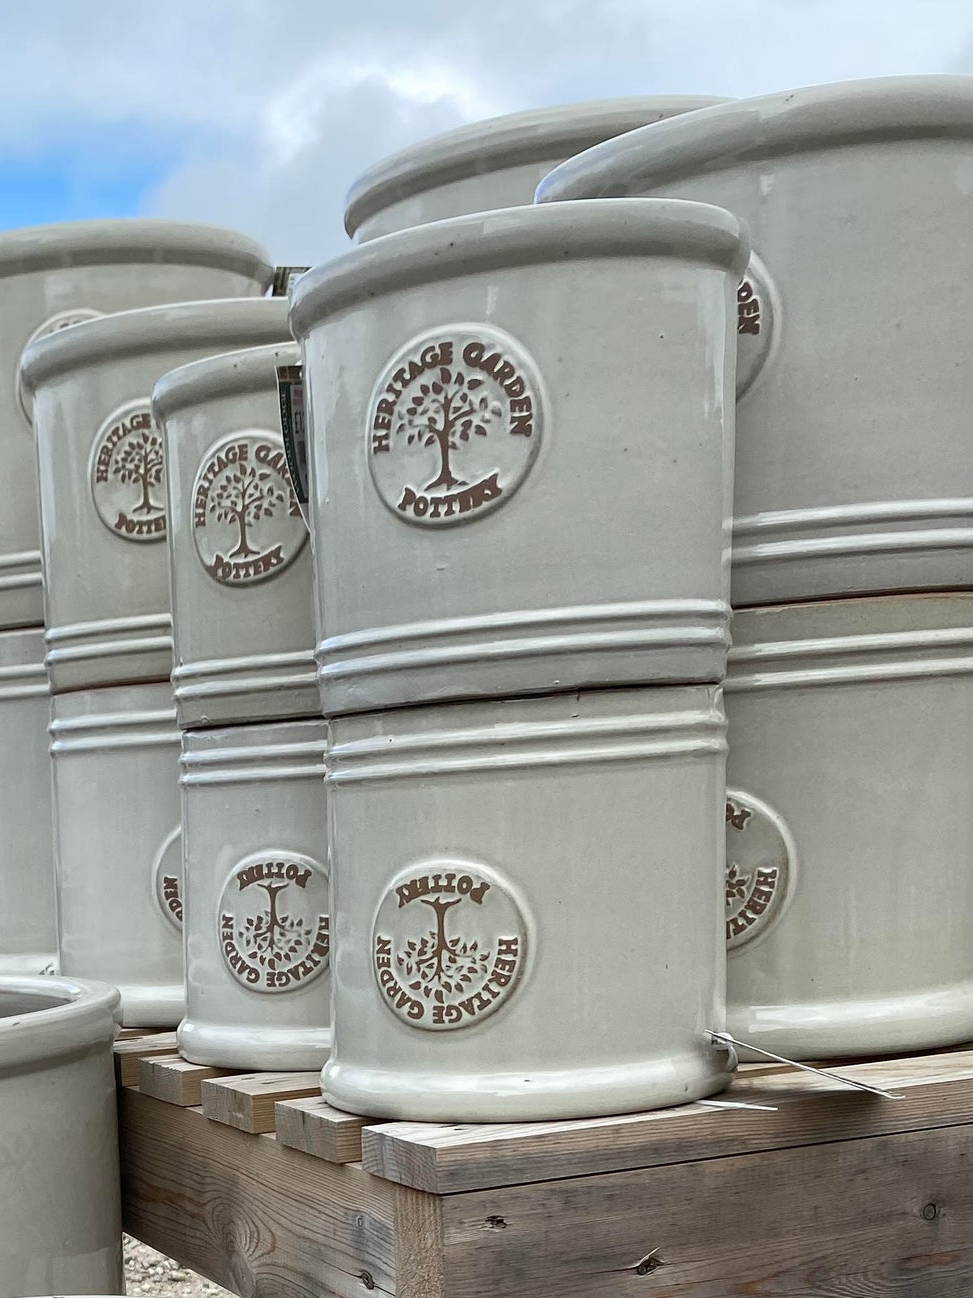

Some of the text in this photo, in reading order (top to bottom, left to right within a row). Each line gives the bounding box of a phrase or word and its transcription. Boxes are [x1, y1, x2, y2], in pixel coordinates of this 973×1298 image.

[737, 281, 760, 335] DEN
[373, 342, 533, 454] HERITAGE GARDEN
[96, 413, 151, 483] HERITAGE
[195, 443, 248, 528] HERITAGE
[115, 512, 166, 535] POTTE
[210, 545, 284, 581] POTTERY
[163, 876, 183, 922] DEN
[726, 870, 777, 939] HERIT
[222, 914, 260, 983] GARDEN
[376, 935, 518, 1024] HERITAGE GARDEN
